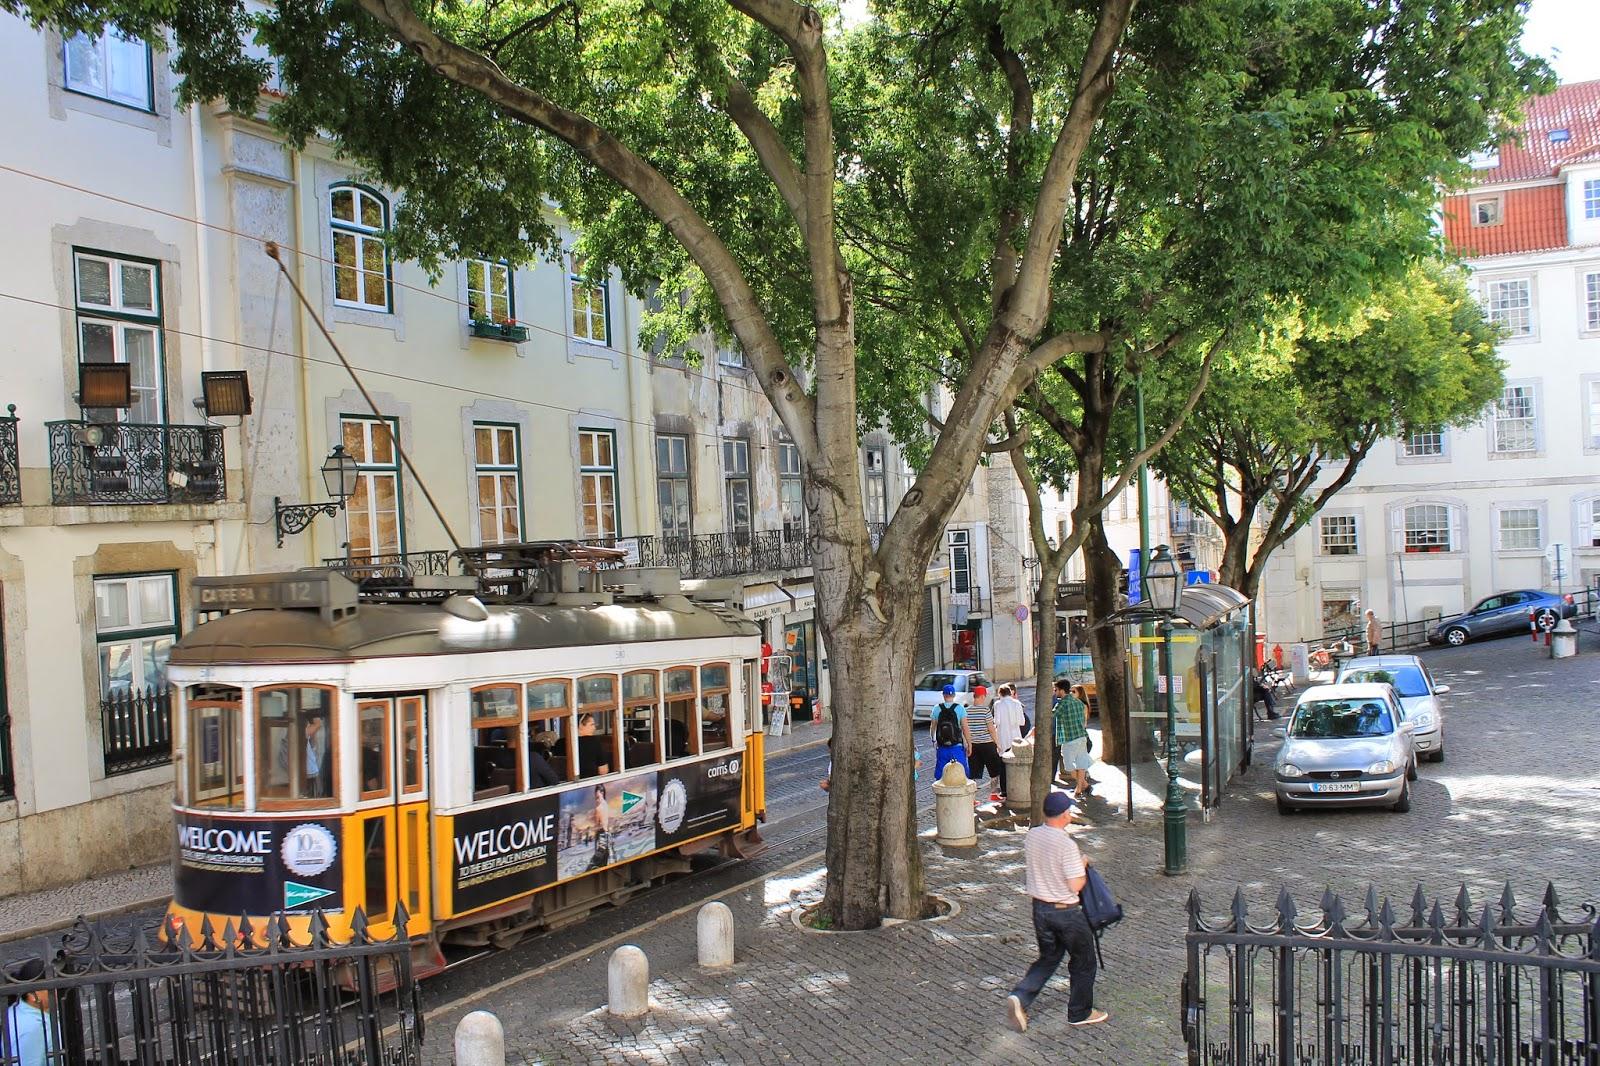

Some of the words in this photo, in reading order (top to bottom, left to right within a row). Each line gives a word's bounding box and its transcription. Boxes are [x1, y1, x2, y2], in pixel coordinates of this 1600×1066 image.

[288, 582, 311, 601] 12
[177, 823, 272, 854] WELCOME
[454, 814, 555, 865] WELCOME
[496, 854, 514, 866] PLACE
[522, 845, 547, 858] FASHION
